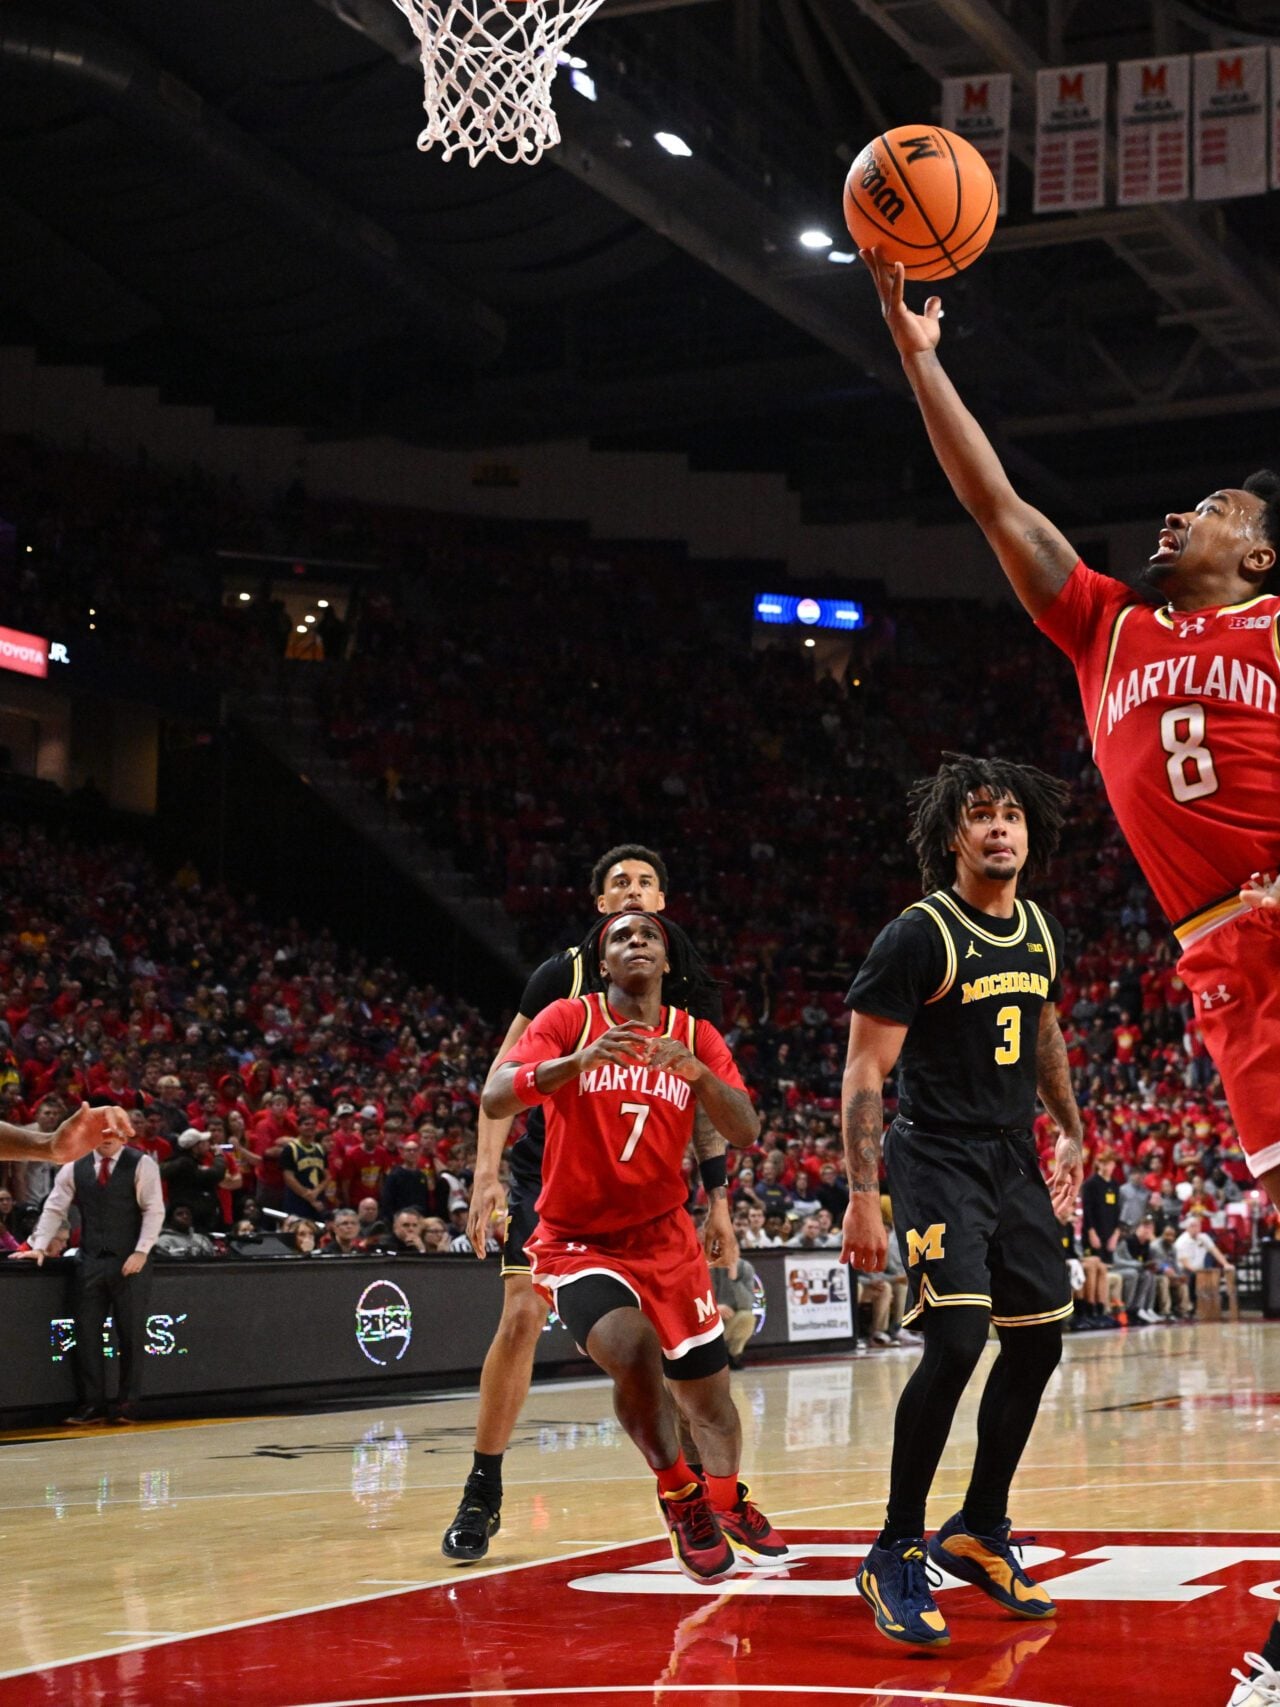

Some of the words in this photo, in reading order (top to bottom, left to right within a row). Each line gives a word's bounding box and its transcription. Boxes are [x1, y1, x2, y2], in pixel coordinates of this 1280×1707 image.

[1059, 73, 1085, 103] M
[1142, 65, 1167, 96] M
[1218, 57, 1243, 89] M
[963, 81, 989, 112] M
[898, 136, 938, 165] M
[1107, 655, 1277, 736] MARYLAND
[1160, 703, 1218, 802] 8
[961, 971, 1049, 1004] MICHIGAN
[994, 1005, 1021, 1065] 3
[578, 1064, 691, 1112] MARYLAND
[618, 1101, 650, 1163] 7
[906, 1223, 946, 1267] M
[694, 1289, 717, 1323] M
